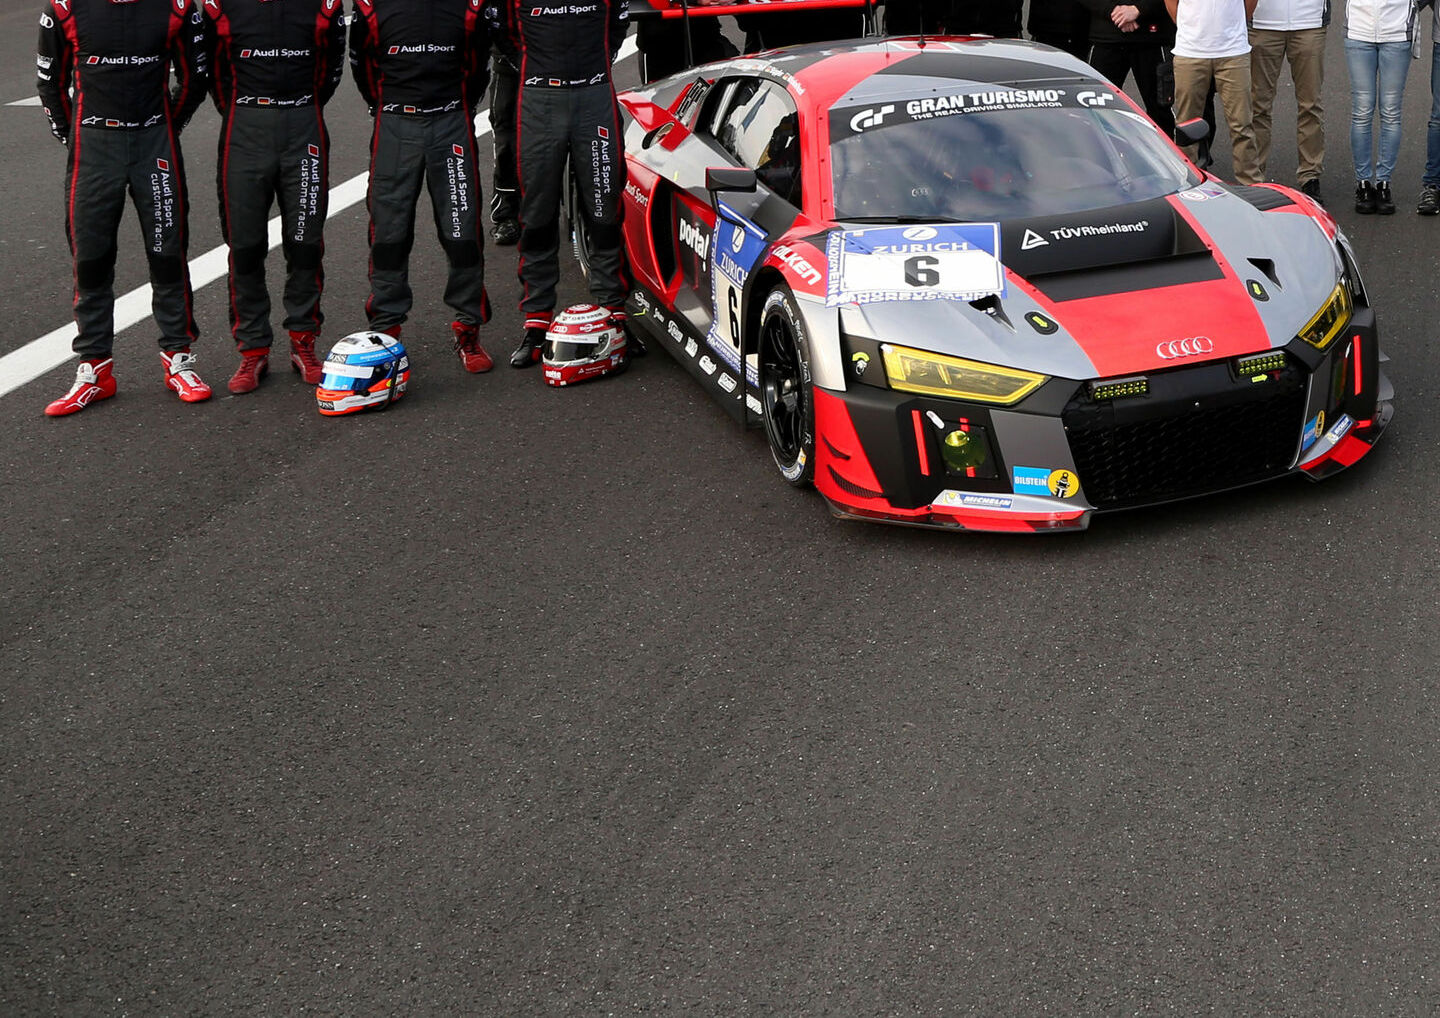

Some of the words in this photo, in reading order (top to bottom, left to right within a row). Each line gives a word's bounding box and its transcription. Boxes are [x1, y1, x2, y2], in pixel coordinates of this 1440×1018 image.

[543, 5, 568, 15] Audi
[569, 4, 597, 15] Sport
[101, 56, 129, 65] Audi
[131, 54, 160, 65] Sport
[253, 49, 279, 57] Audi
[281, 48, 310, 58] Sport
[400, 44, 426, 53] Audi
[427, 43, 456, 53] Sport
[906, 92, 967, 115] GRAN
[911, 113, 929, 121] THE
[929, 108, 962, 119] REAL
[962, 104, 1005, 115] DRIVING
[1005, 101, 1063, 111] SIMULATOR
[591, 139, 601, 188] customer
[600, 139, 611, 164] Audi
[299, 158, 309, 209] customer
[310, 158, 320, 184] Audi
[455, 156, 466, 182] Audi
[600, 164, 611, 194] Sport
[150, 173, 162, 221] customer
[160, 172, 172, 199] Audi
[446, 157, 458, 204] customer
[452, 205, 461, 239] racing
[458, 182, 469, 212] Sport
[624, 179, 637, 196] Audi
[634, 188, 649, 208] Sport
[162, 198, 174, 228] Sport
[308, 185, 320, 216] Sport
[594, 189, 603, 218] racing
[153, 222, 162, 253] racing
[294, 211, 306, 242] racing
[873, 241, 968, 254] ZURICH
[721, 252, 749, 286] ZURICH
[904, 255, 940, 288] 6
[728, 285, 740, 349] 6
[1014, 476, 1048, 487] BILSTEIN
[963, 495, 1012, 508] MICHELIN
